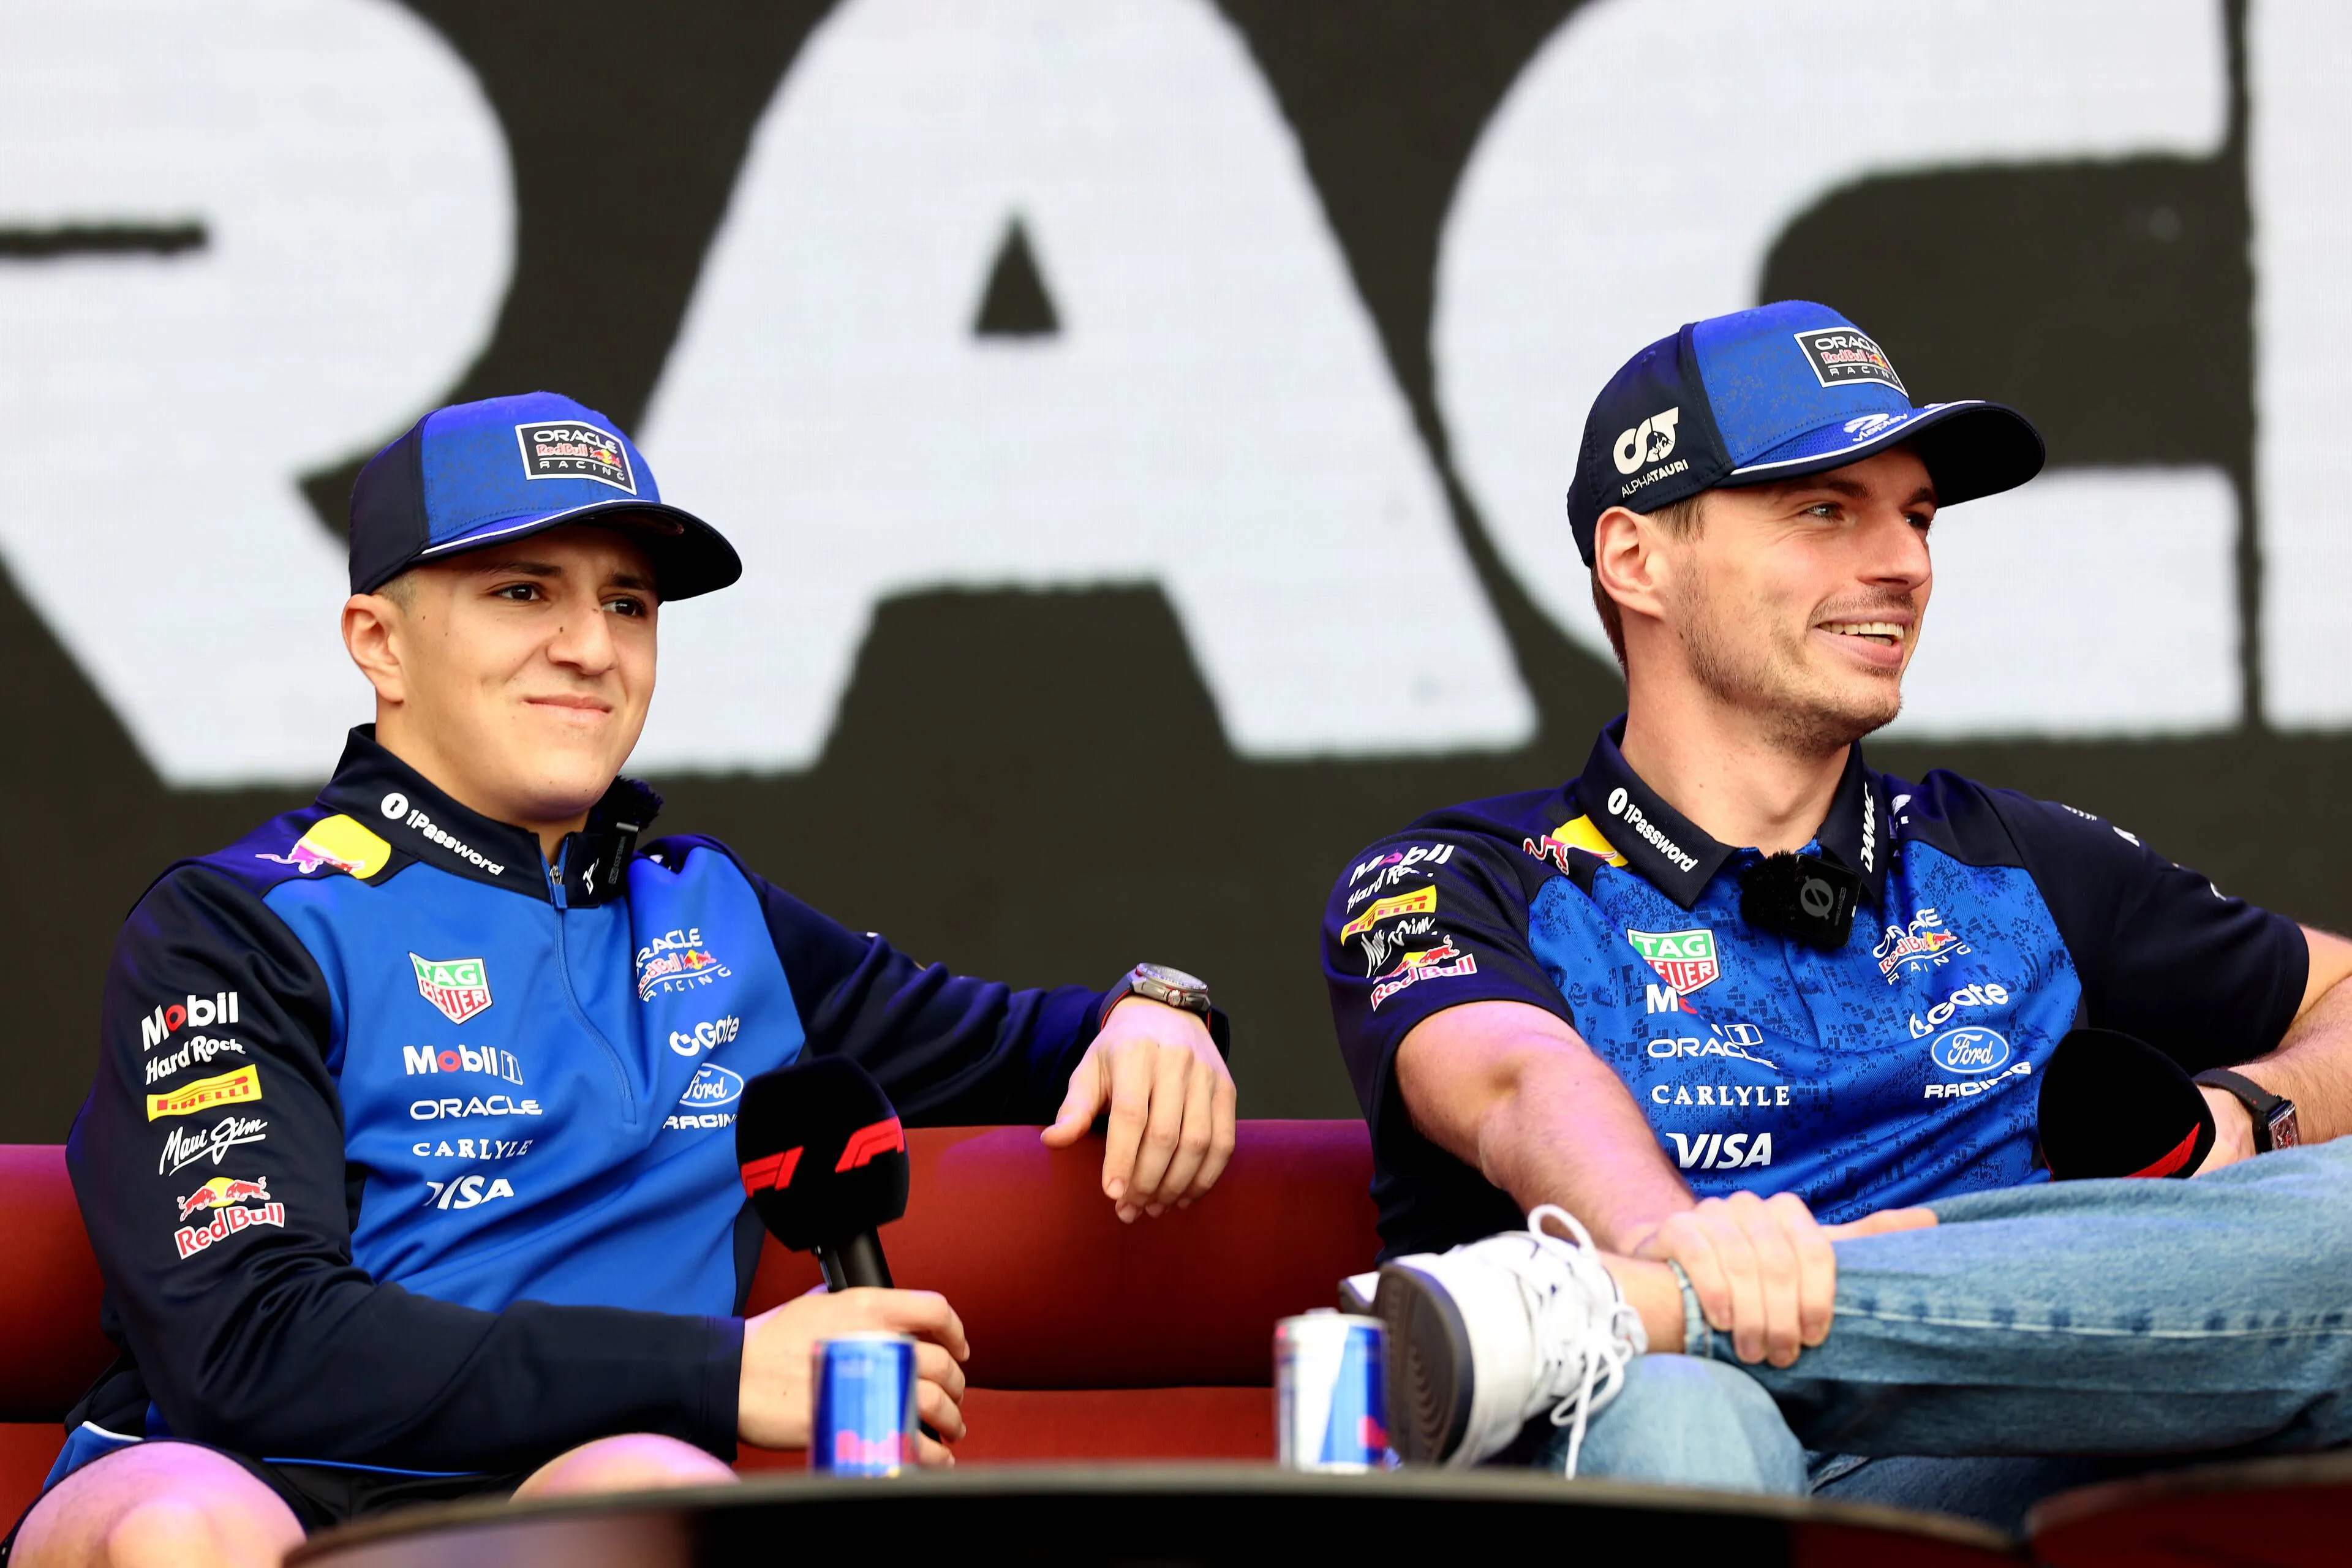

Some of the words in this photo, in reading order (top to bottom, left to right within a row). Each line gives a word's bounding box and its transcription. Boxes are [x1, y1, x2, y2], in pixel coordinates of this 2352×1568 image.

[533, 429, 618, 454] ORACLE
[540, 460, 625, 481] RACING
[1621, 459, 1689, 498] ALPHATAURI
[405, 809, 505, 876] 1Password
[1623, 804, 1698, 873] 1Password
[1347, 868, 1386, 914] Hard
[636, 928, 703, 970] RACLE
[1635, 935, 1706, 957] TAG
[416, 960, 478, 986] TAG
[643, 966, 731, 1002] RACING
[1648, 960, 1713, 990] EUER
[422, 981, 485, 1018] HEUER
[141, 992, 238, 1052] Mobil
[146, 1041, 190, 1085] Hard
[190, 1036, 246, 1063] Rock
[402, 1044, 498, 1076] Mobil
[1947, 1033, 1994, 1065] Ford
[157, 1076, 249, 1111] PIRELLI
[682, 1070, 728, 1099] Ford
[1652, 1085, 1790, 1106] CARLYLE
[410, 1095, 543, 1120] ORACLE
[663, 1114, 737, 1129] RACIN
[159, 1126, 208, 1175] Maui
[210, 1117, 268, 1165] Jim
[412, 1139, 533, 1160] CARLYLE
[1665, 1133, 1771, 1169] VISA
